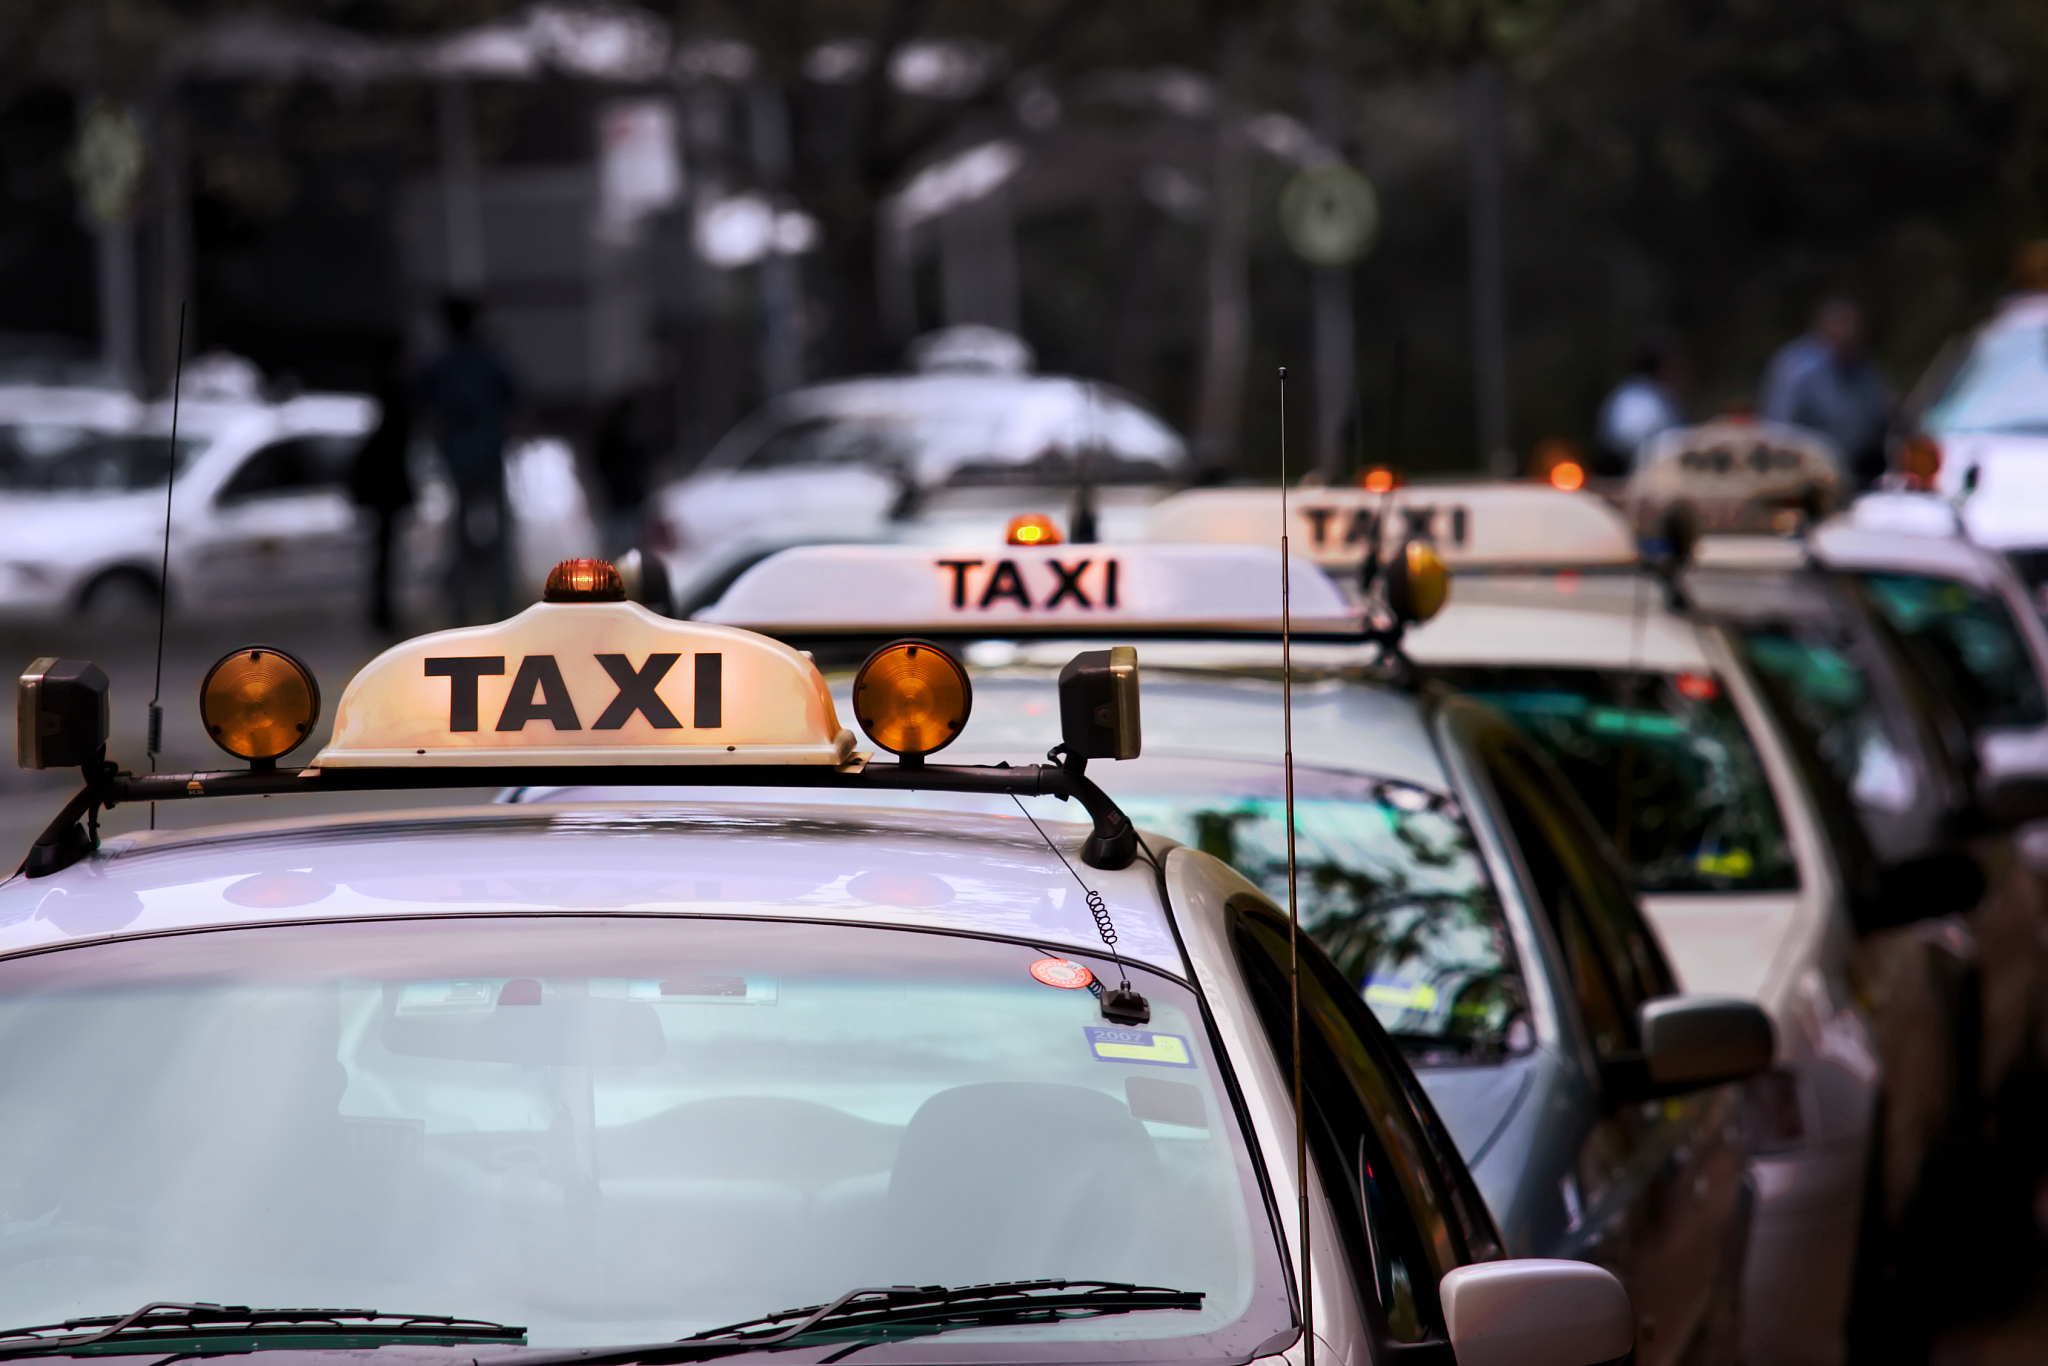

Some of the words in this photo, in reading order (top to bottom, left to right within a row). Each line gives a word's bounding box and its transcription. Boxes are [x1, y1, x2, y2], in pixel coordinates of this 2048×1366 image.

[1302, 505, 1469, 547] TAXI
[937, 559, 1119, 608] TAXI
[424, 652, 722, 732] TAXI
[1094, 1030, 1142, 1041] 2007
